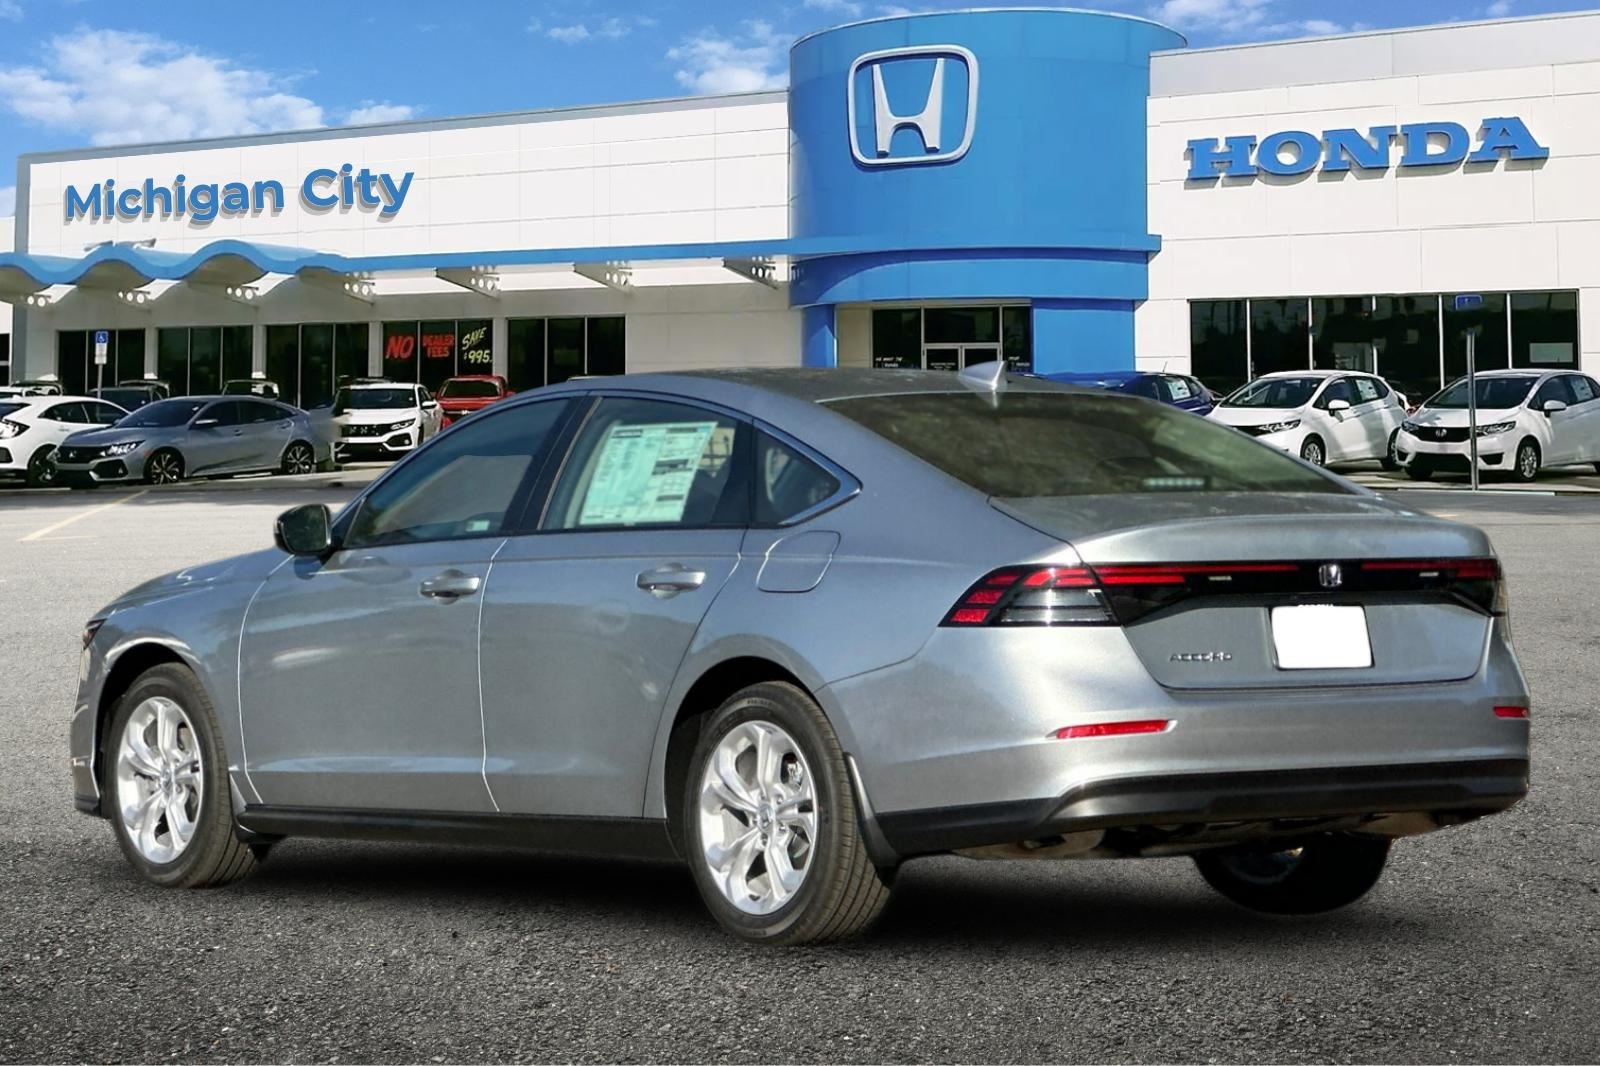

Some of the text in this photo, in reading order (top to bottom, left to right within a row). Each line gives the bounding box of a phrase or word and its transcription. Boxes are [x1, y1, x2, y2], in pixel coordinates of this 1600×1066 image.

[1186, 116, 1550, 182] HONDA
[64, 163, 415, 222] Michigan City
[386, 335, 414, 359] NO
[461, 327, 487, 350] SAVE
[1169, 652, 1233, 662] ACCORD
